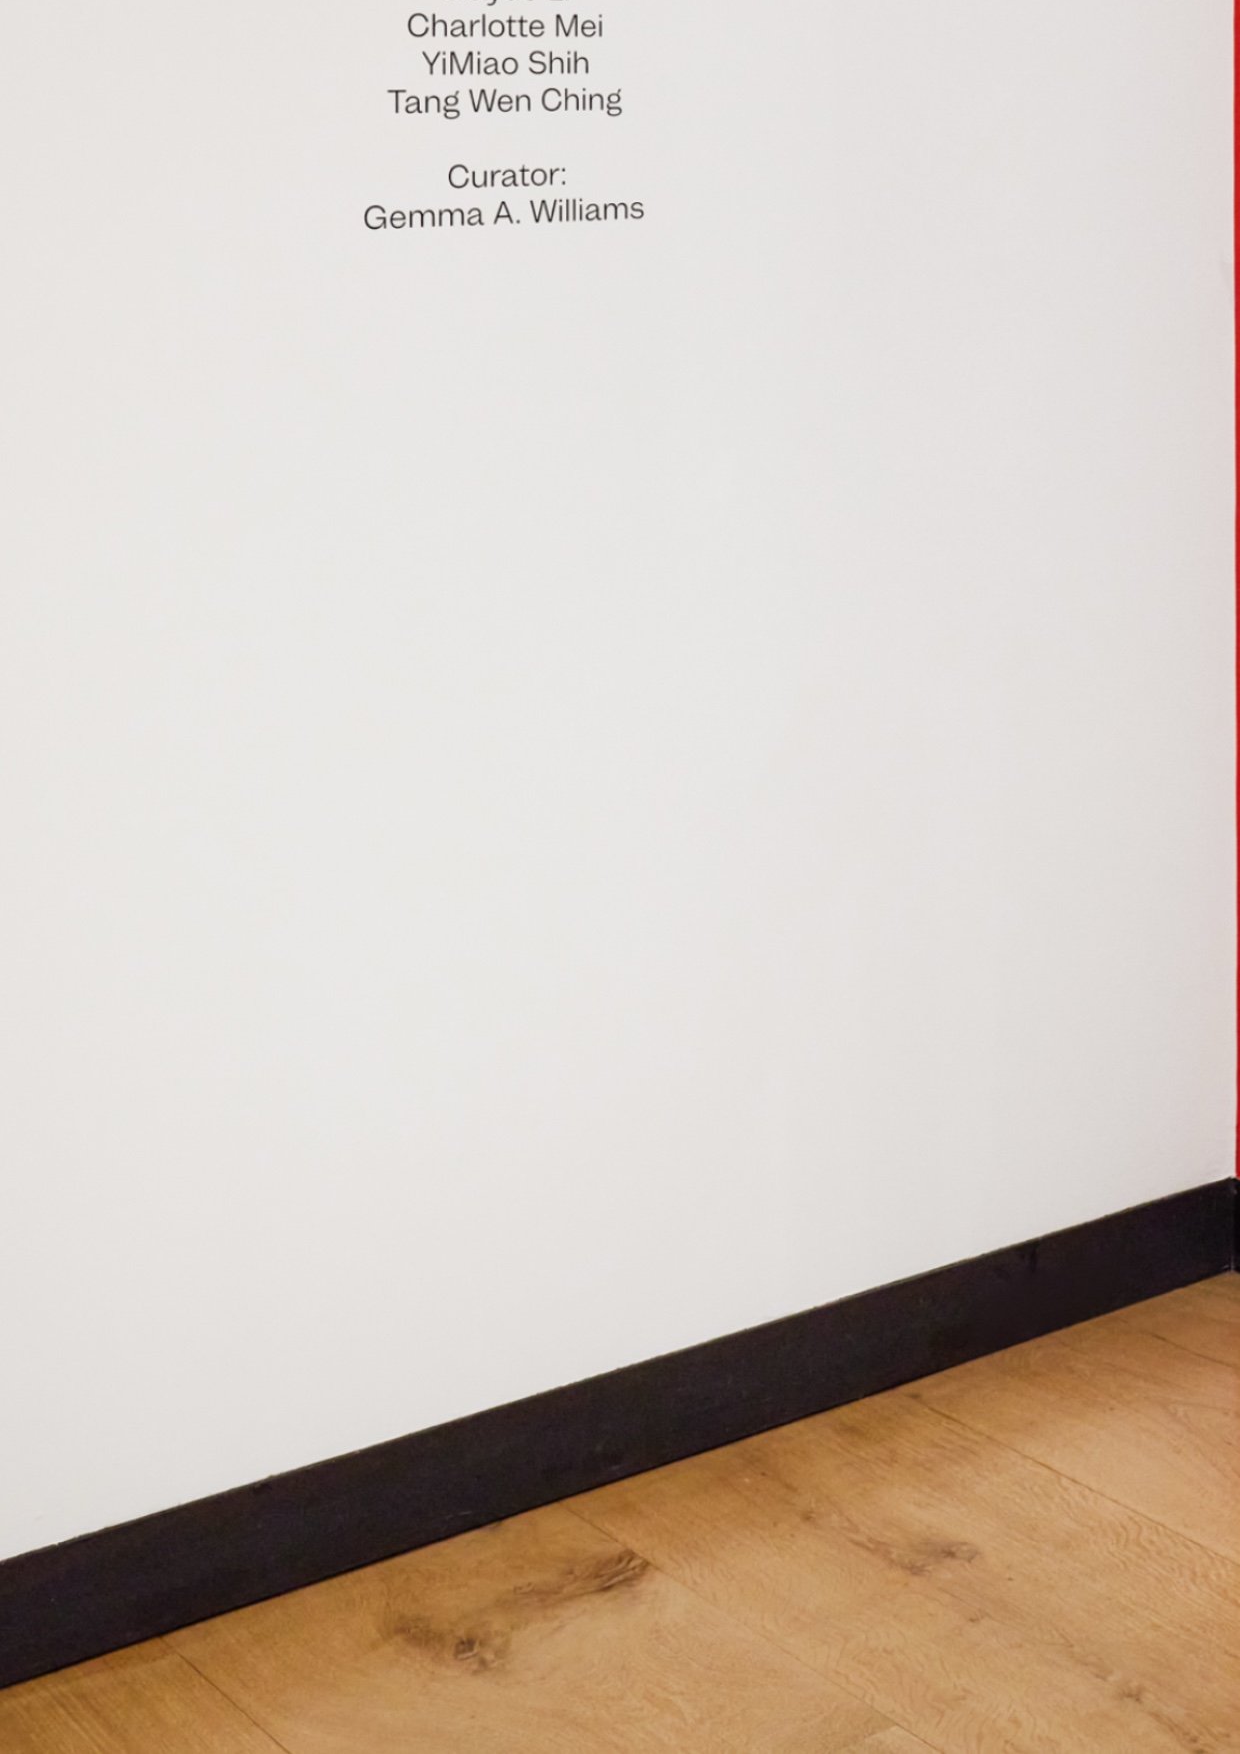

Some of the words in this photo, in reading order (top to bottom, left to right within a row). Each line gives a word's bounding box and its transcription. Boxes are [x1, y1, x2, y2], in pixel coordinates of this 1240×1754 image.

[407, 12, 546, 39] Charlotte
[555, 13, 603, 39] Mei
[421, 50, 520, 76] YiMiao
[528, 49, 590, 76] Shih
[386, 88, 461, 121] Tang
[468, 88, 532, 113] Wen
[540, 87, 623, 118] Ching
[447, 163, 566, 190] Curator:
[363, 204, 485, 231] Gemma
[492, 200, 521, 225] A.
[529, 197, 645, 224] Williams
